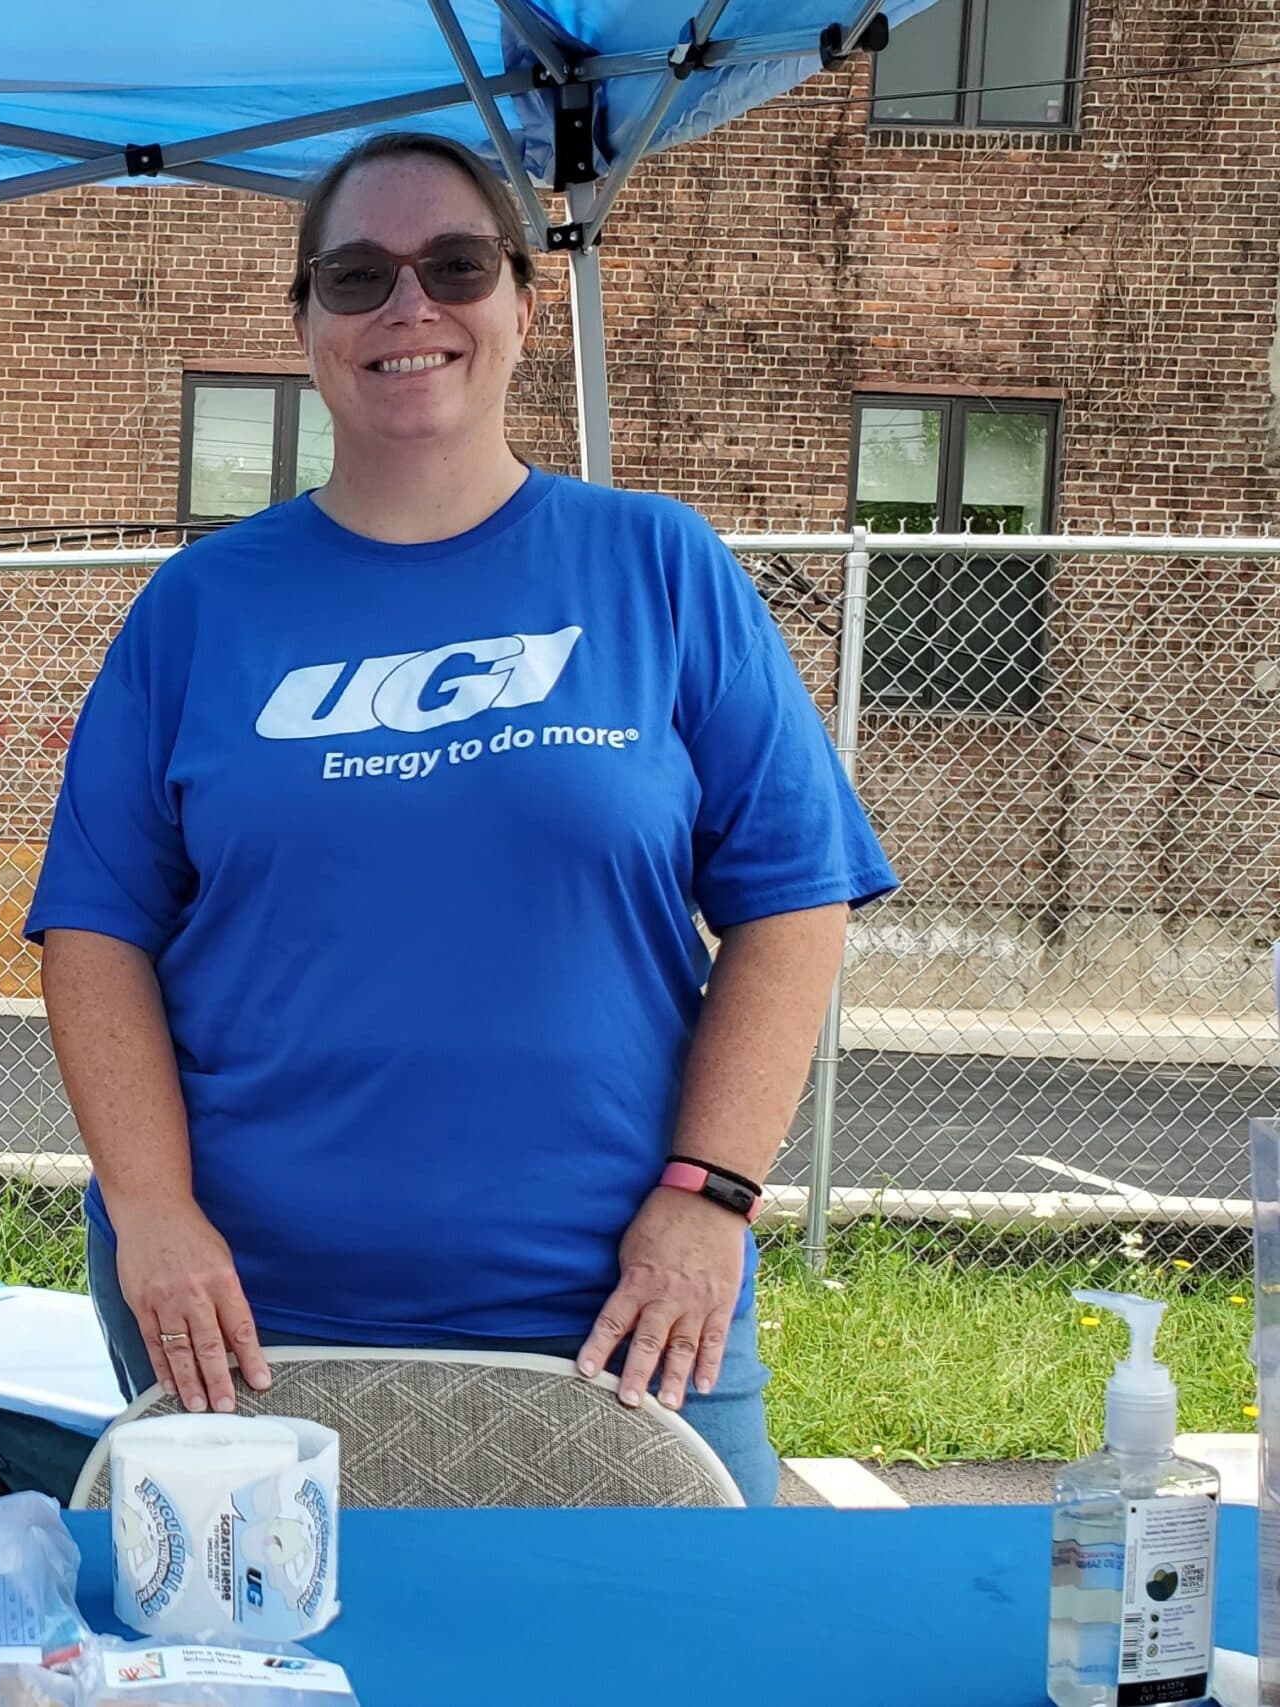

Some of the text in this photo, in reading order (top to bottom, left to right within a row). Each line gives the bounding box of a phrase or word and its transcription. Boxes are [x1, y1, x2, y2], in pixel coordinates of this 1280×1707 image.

[255, 625, 583, 739] UGI
[322, 747, 440, 780] Energy
[447, 741, 483, 764] to
[489, 725, 535, 753] do
[140, 1476, 159, 1500] IF
[154, 1492, 183, 1532] YOU
[220, 1513, 231, 1567] SCRATCH
[140, 1587, 171, 1618] GAS
